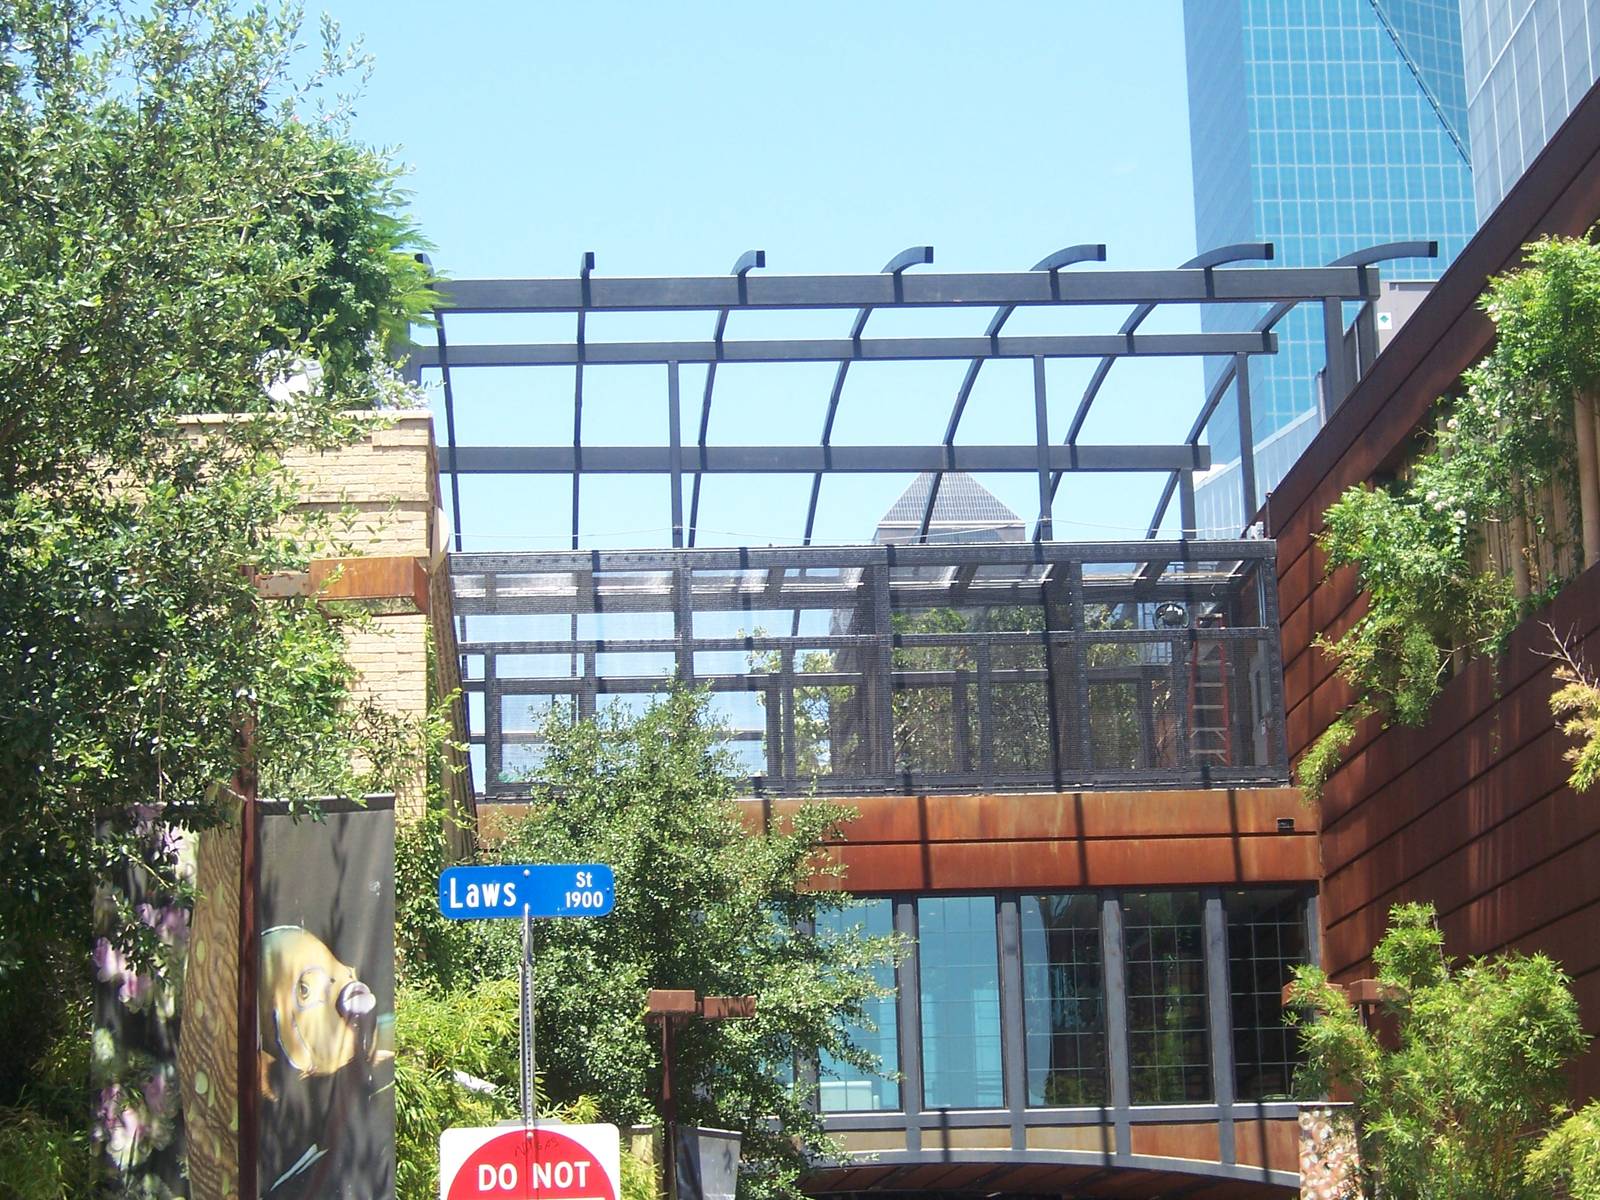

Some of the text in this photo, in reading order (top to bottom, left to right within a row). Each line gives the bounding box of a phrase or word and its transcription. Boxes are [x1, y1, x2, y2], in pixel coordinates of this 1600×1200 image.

[576, 871, 593, 888] St
[450, 877, 516, 909] Laws
[565, 891, 604, 908] 1900
[478, 1161, 591, 1191] DO NOT
